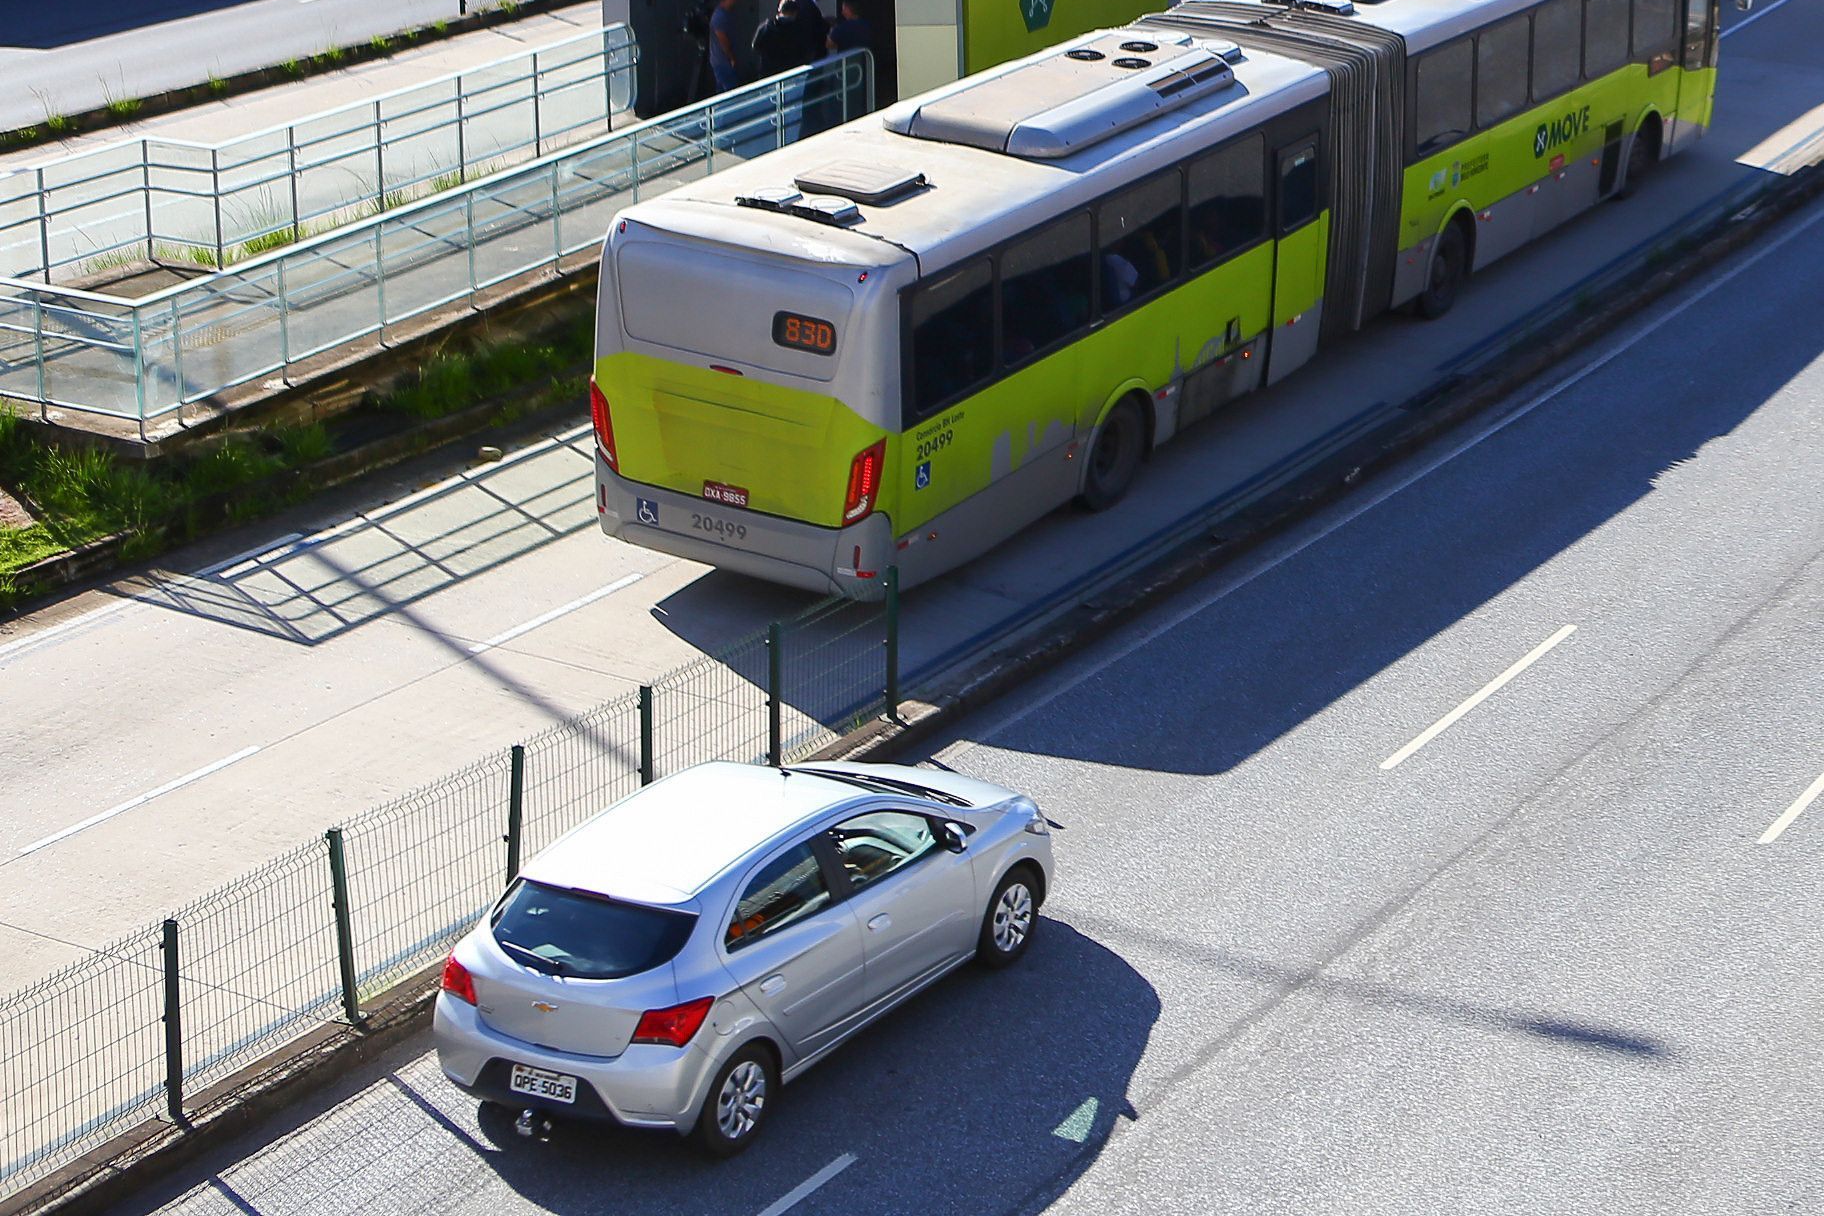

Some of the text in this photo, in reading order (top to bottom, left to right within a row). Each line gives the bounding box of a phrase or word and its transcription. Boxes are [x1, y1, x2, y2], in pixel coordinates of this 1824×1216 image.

[1548, 105, 1590, 150] MOVE
[916, 429, 954, 462] 20499
[691, 514, 748, 541] 20499
